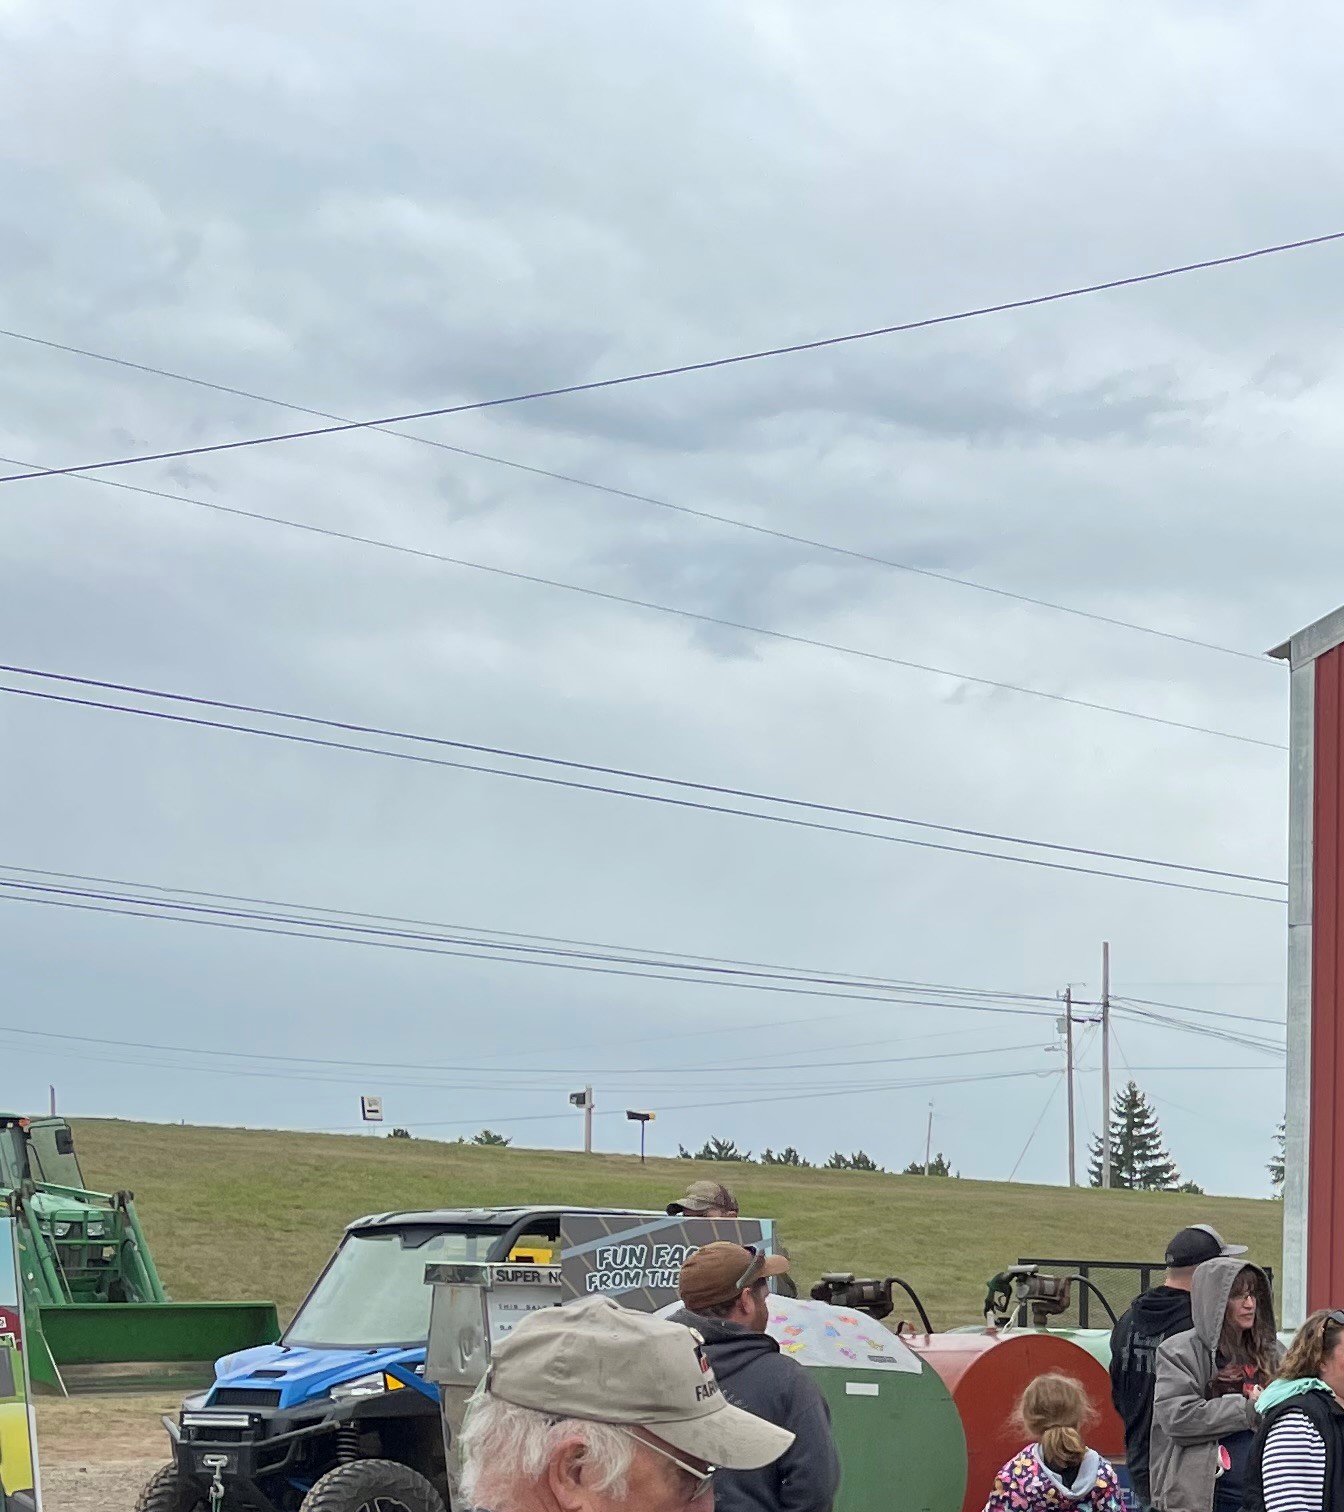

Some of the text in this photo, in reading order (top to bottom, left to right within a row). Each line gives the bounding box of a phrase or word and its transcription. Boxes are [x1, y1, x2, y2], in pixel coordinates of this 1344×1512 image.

[597, 1245, 647, 1269] FUN
[496, 1269, 541, 1282] SUPER
[586, 1269, 643, 1291] FROM
